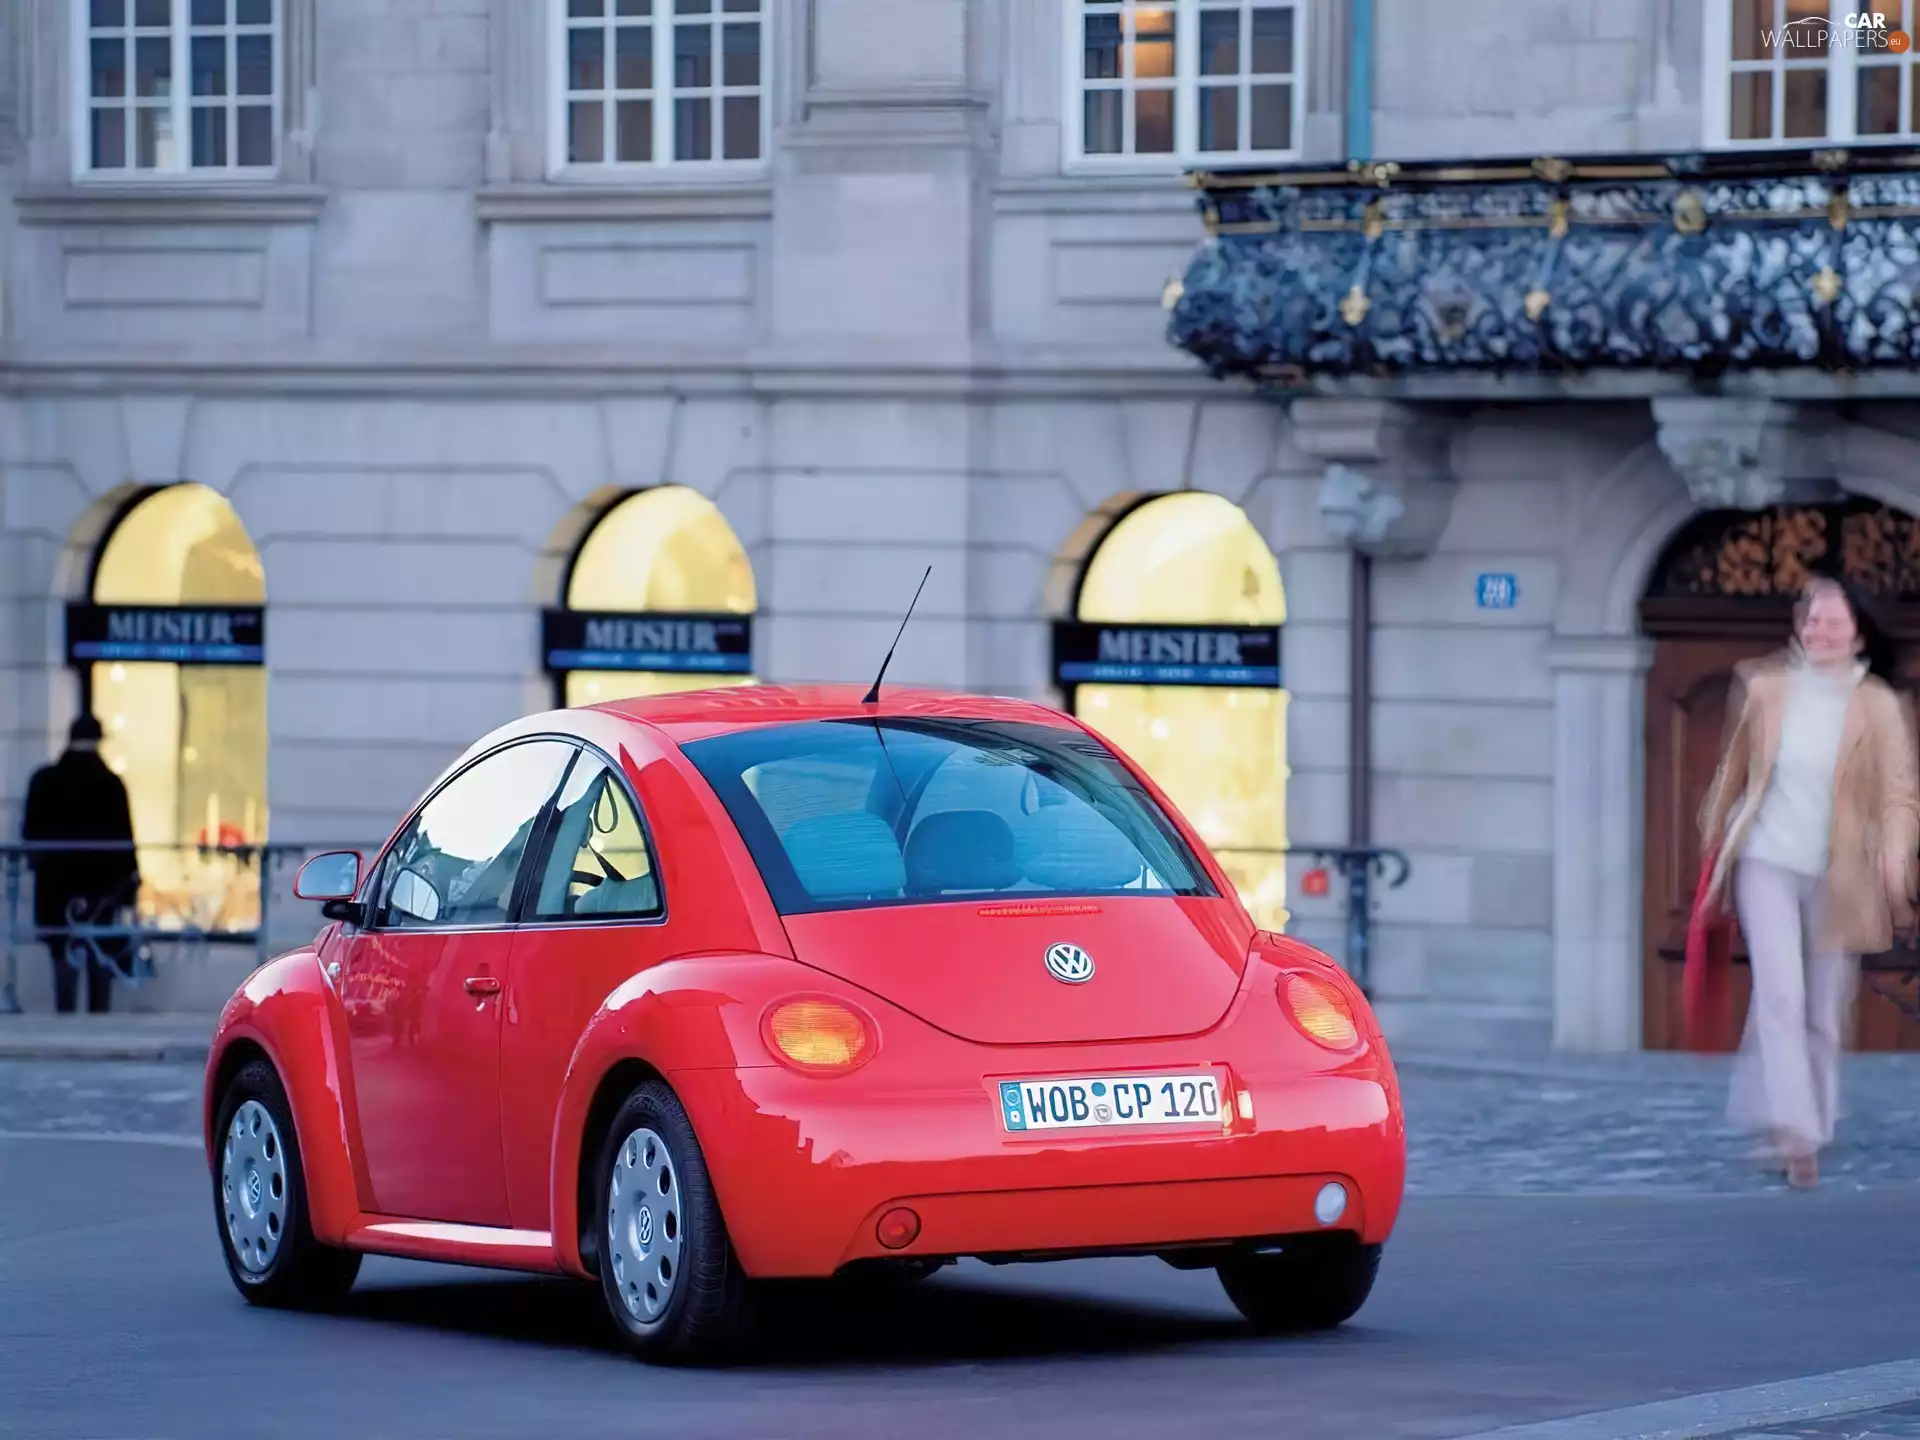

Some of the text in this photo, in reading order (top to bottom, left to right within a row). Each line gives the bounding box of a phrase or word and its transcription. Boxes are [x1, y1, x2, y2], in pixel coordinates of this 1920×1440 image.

[108, 611, 234, 643] MEISTER
[586, 619, 719, 652] MEISTER
[1099, 629, 1243, 665] MEISTER
[1026, 1085, 1090, 1123] WOB
[1113, 1083, 1151, 1119] CP
